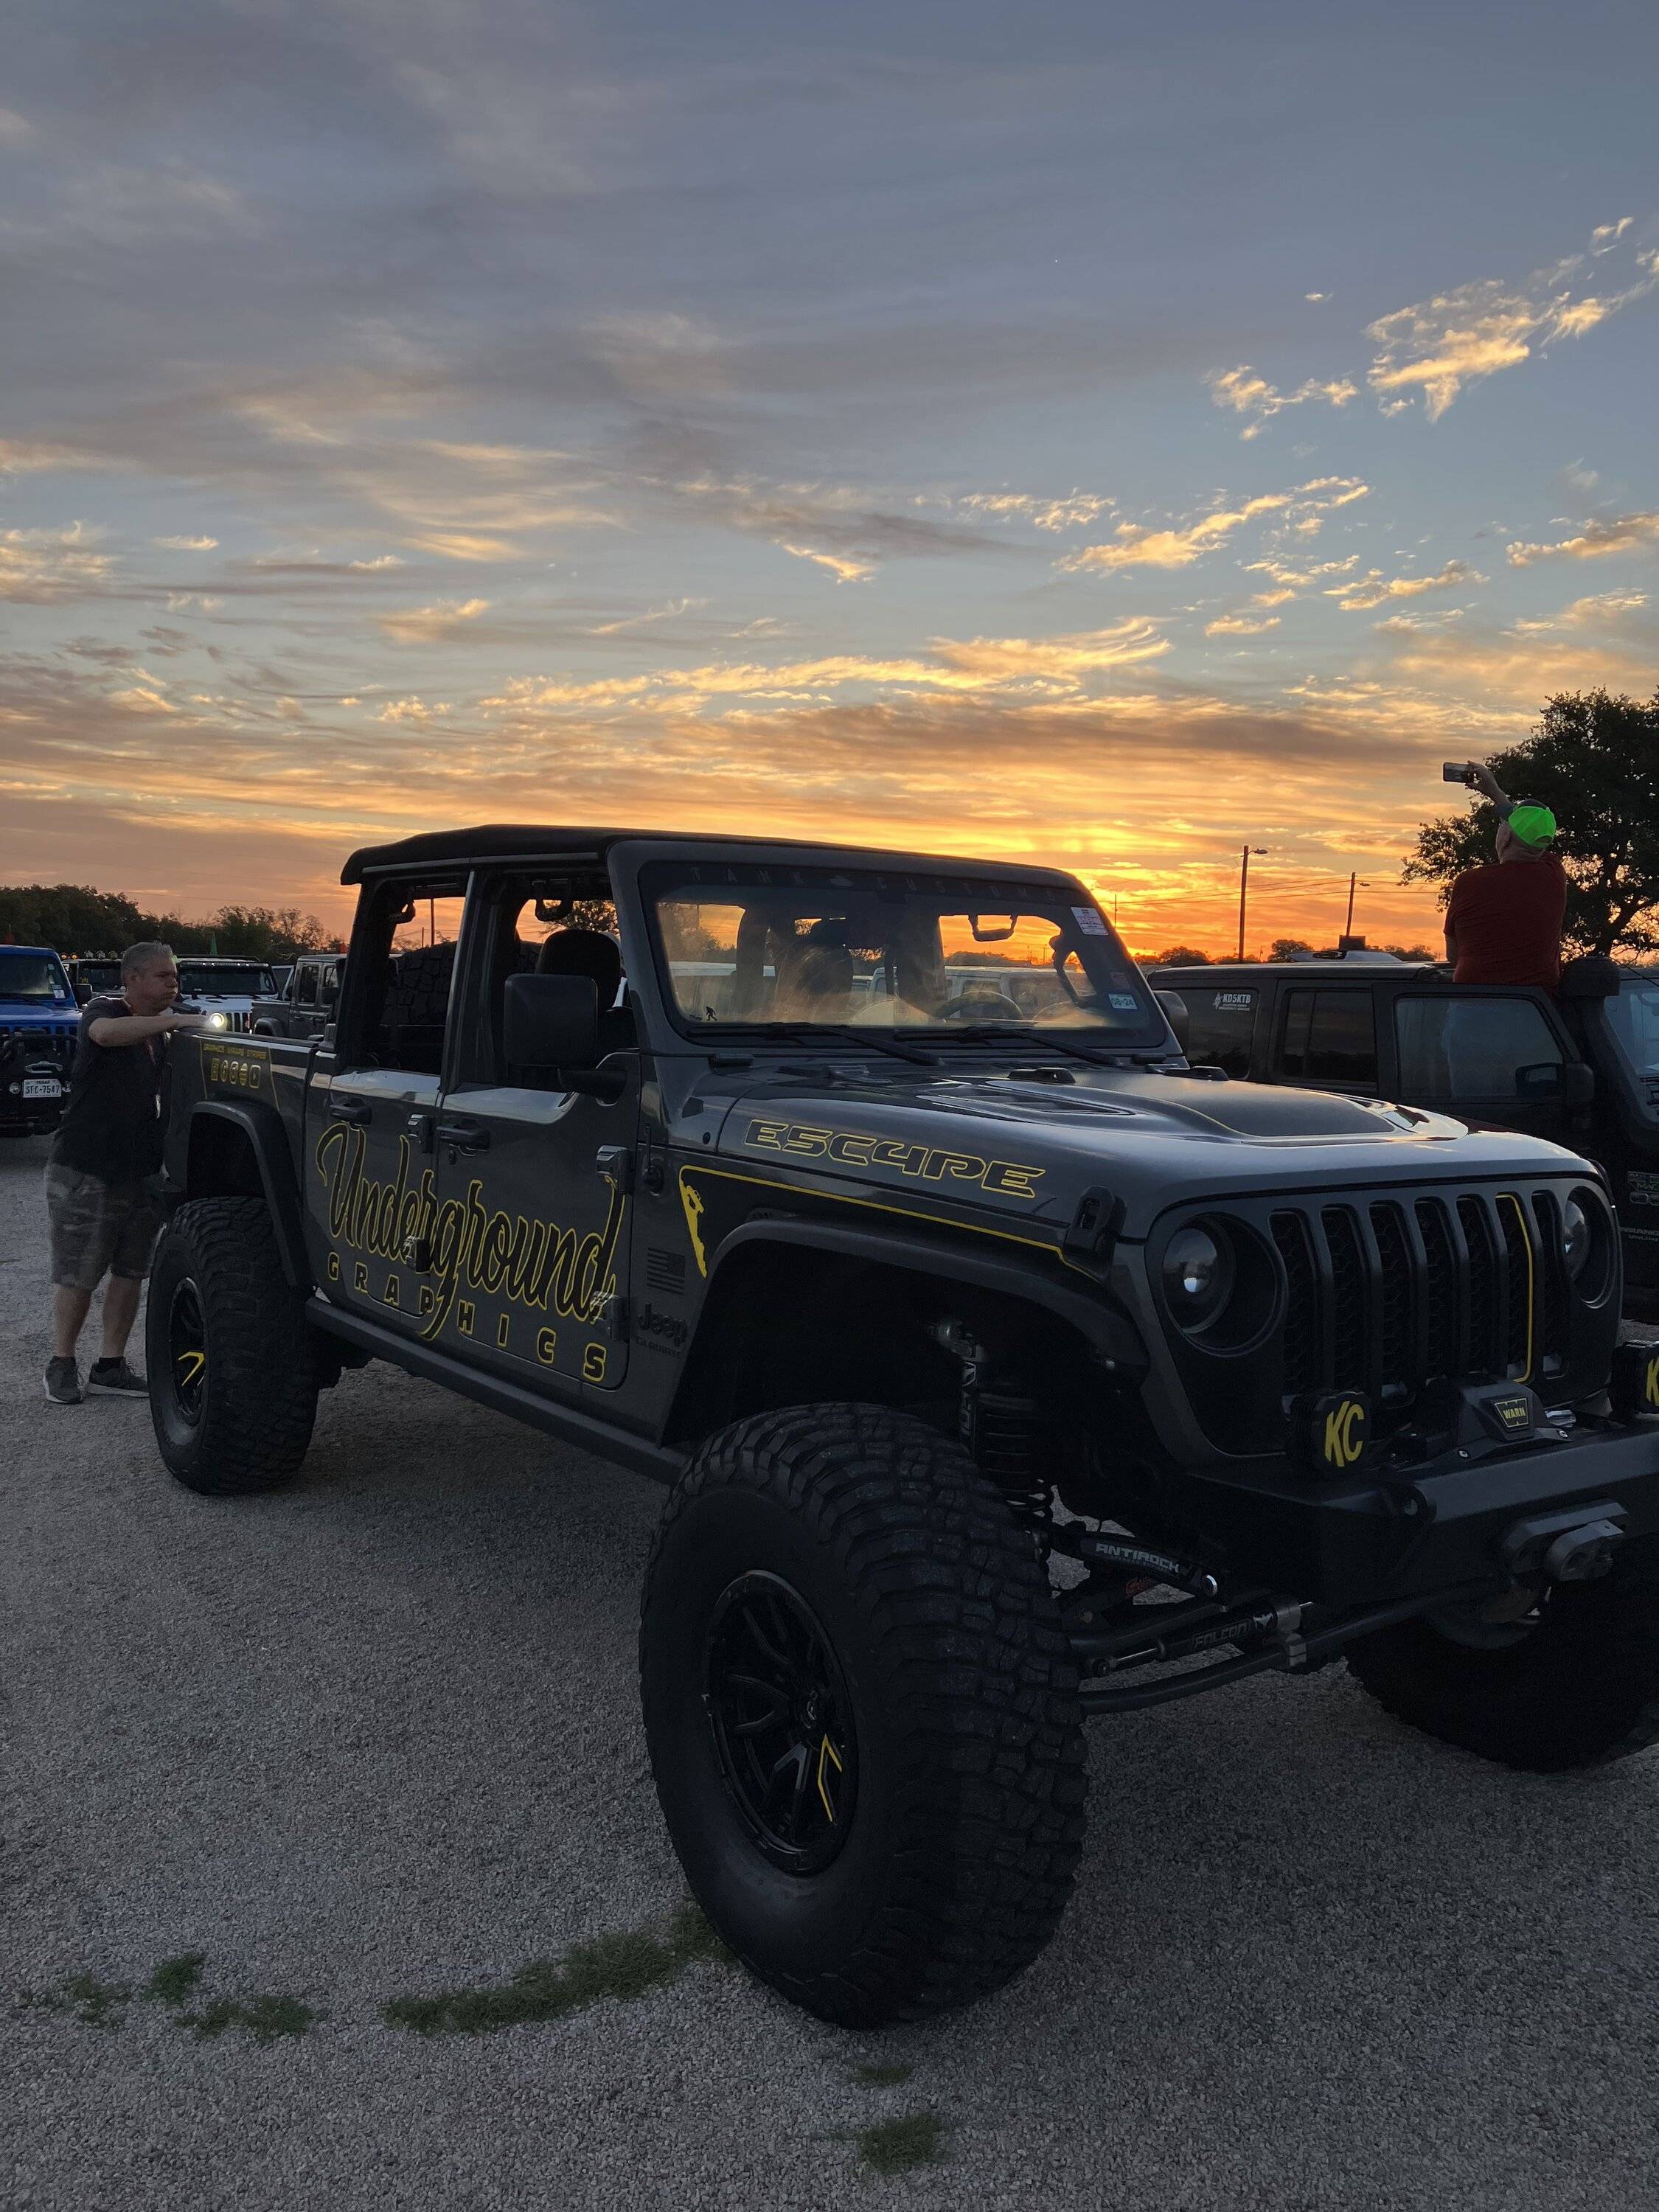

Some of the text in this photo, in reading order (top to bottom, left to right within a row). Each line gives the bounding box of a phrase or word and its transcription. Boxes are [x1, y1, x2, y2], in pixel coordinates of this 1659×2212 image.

[316, 1121, 626, 1341] Underground
[327, 1251, 607, 1382] GRAPHICS
[636, 1302, 687, 1346] Jeep
[1324, 1399, 1365, 1467] KC
[1503, 1407, 1526, 1419] WARN
